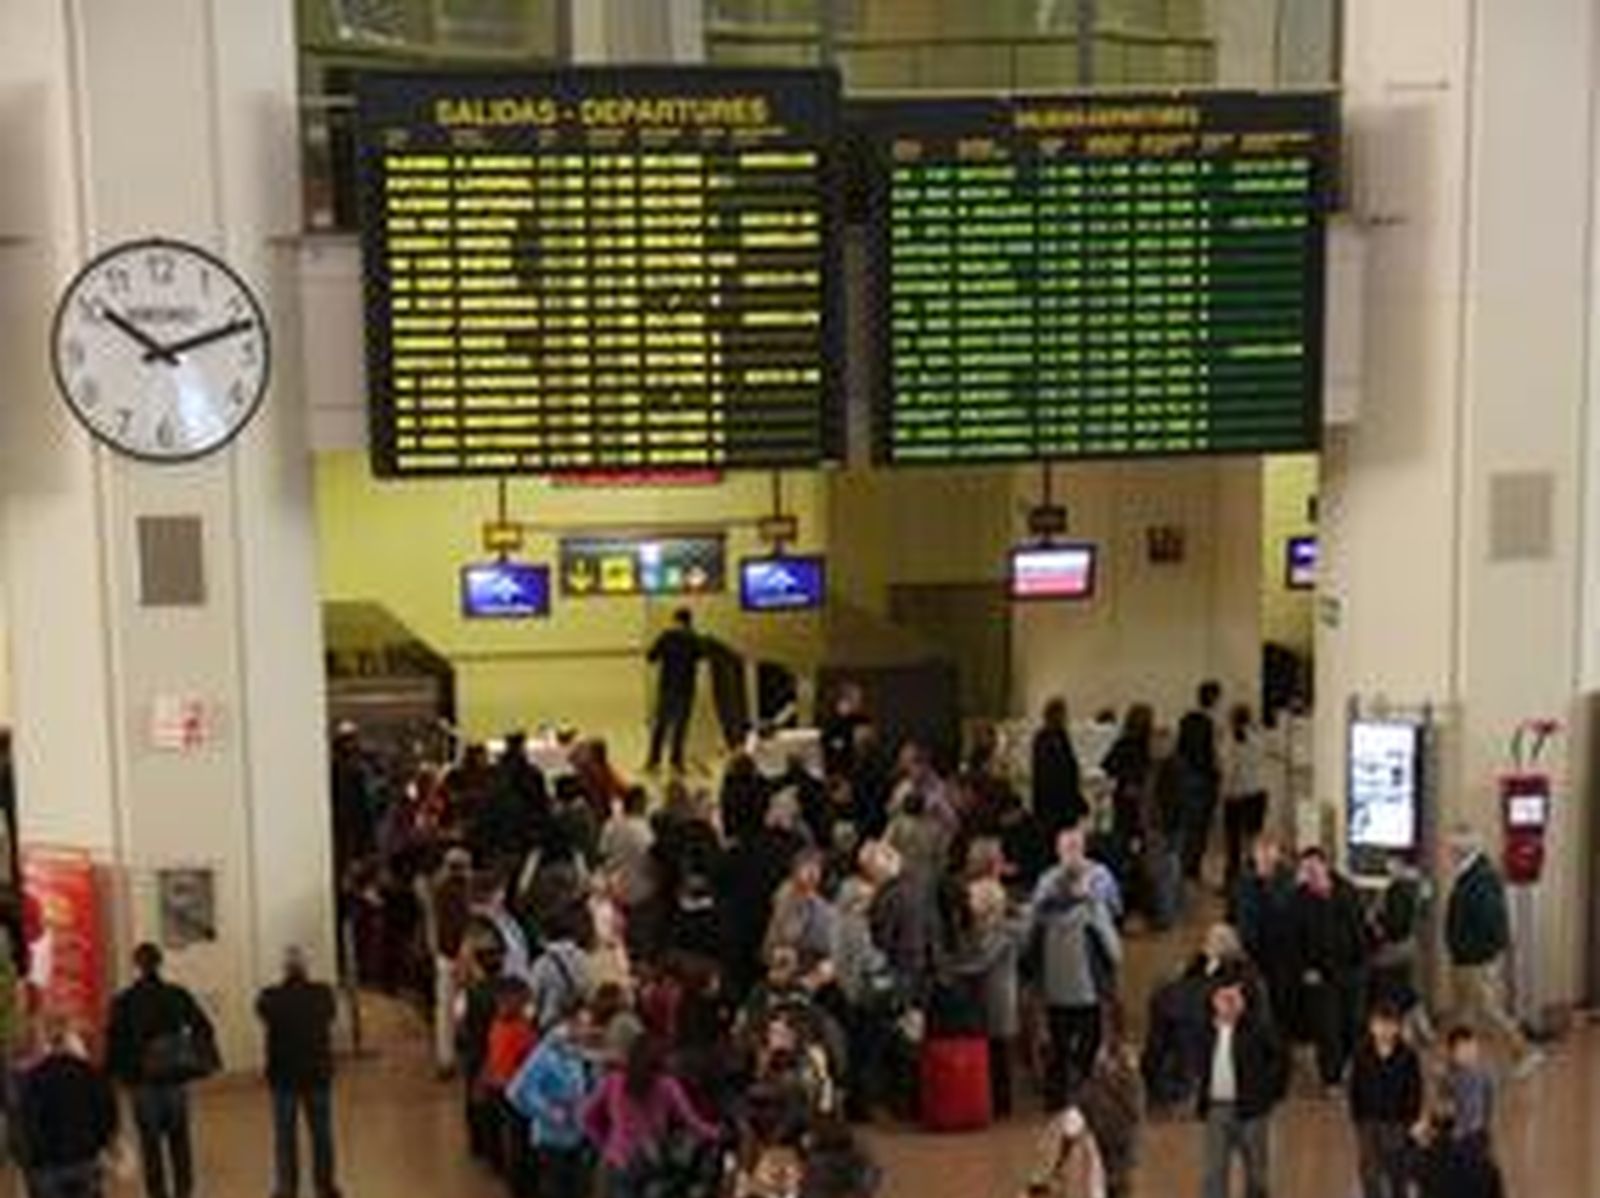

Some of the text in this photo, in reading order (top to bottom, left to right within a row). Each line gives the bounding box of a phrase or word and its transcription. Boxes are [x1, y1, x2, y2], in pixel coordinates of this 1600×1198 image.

[436, 99, 556, 126] SALIDAS
[580, 97, 768, 125] DEPARTURES
[148, 257, 174, 284] 12
